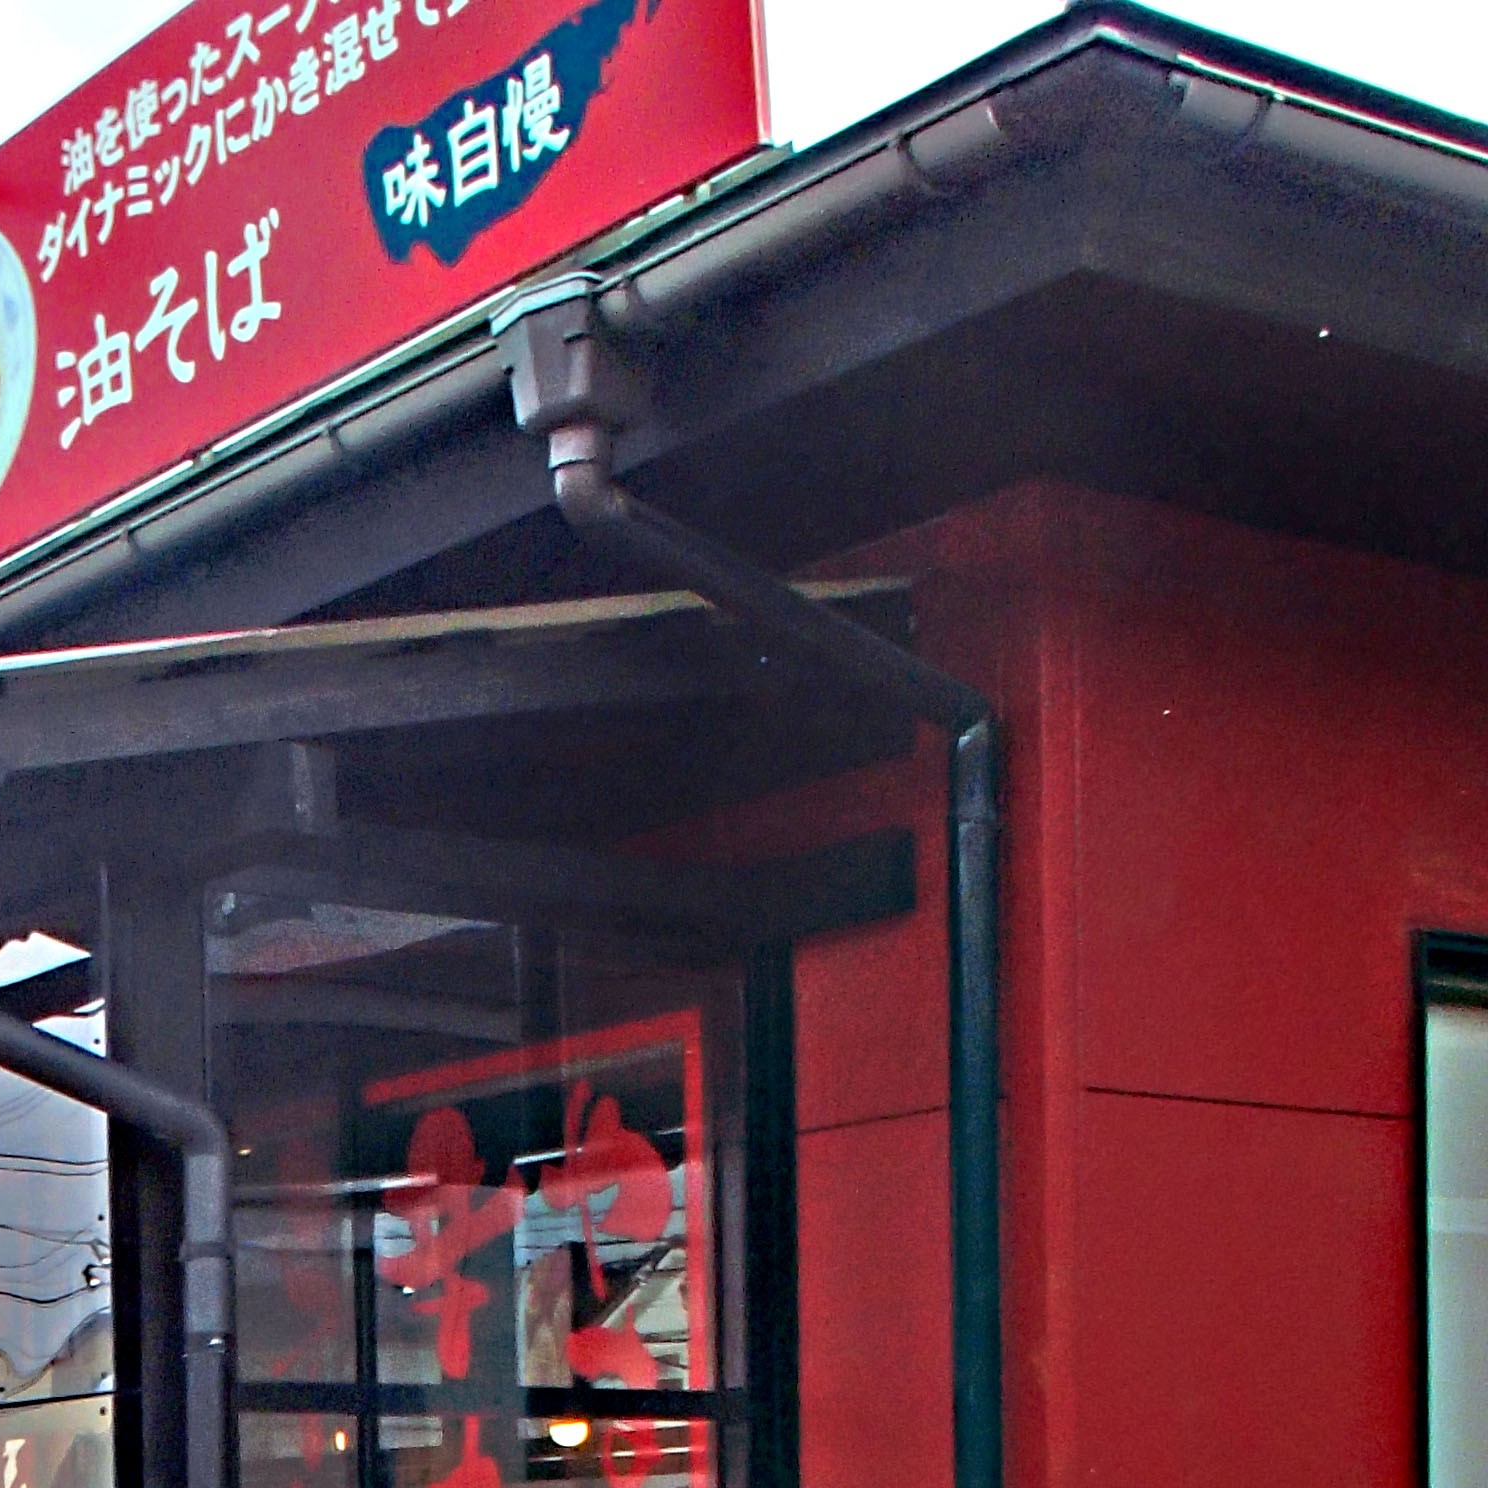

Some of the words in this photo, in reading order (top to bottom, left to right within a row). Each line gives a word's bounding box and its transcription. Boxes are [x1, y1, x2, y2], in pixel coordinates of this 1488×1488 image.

[382, 54, 570, 227] 味自慢
[55, 208, 282, 450] 油そば
